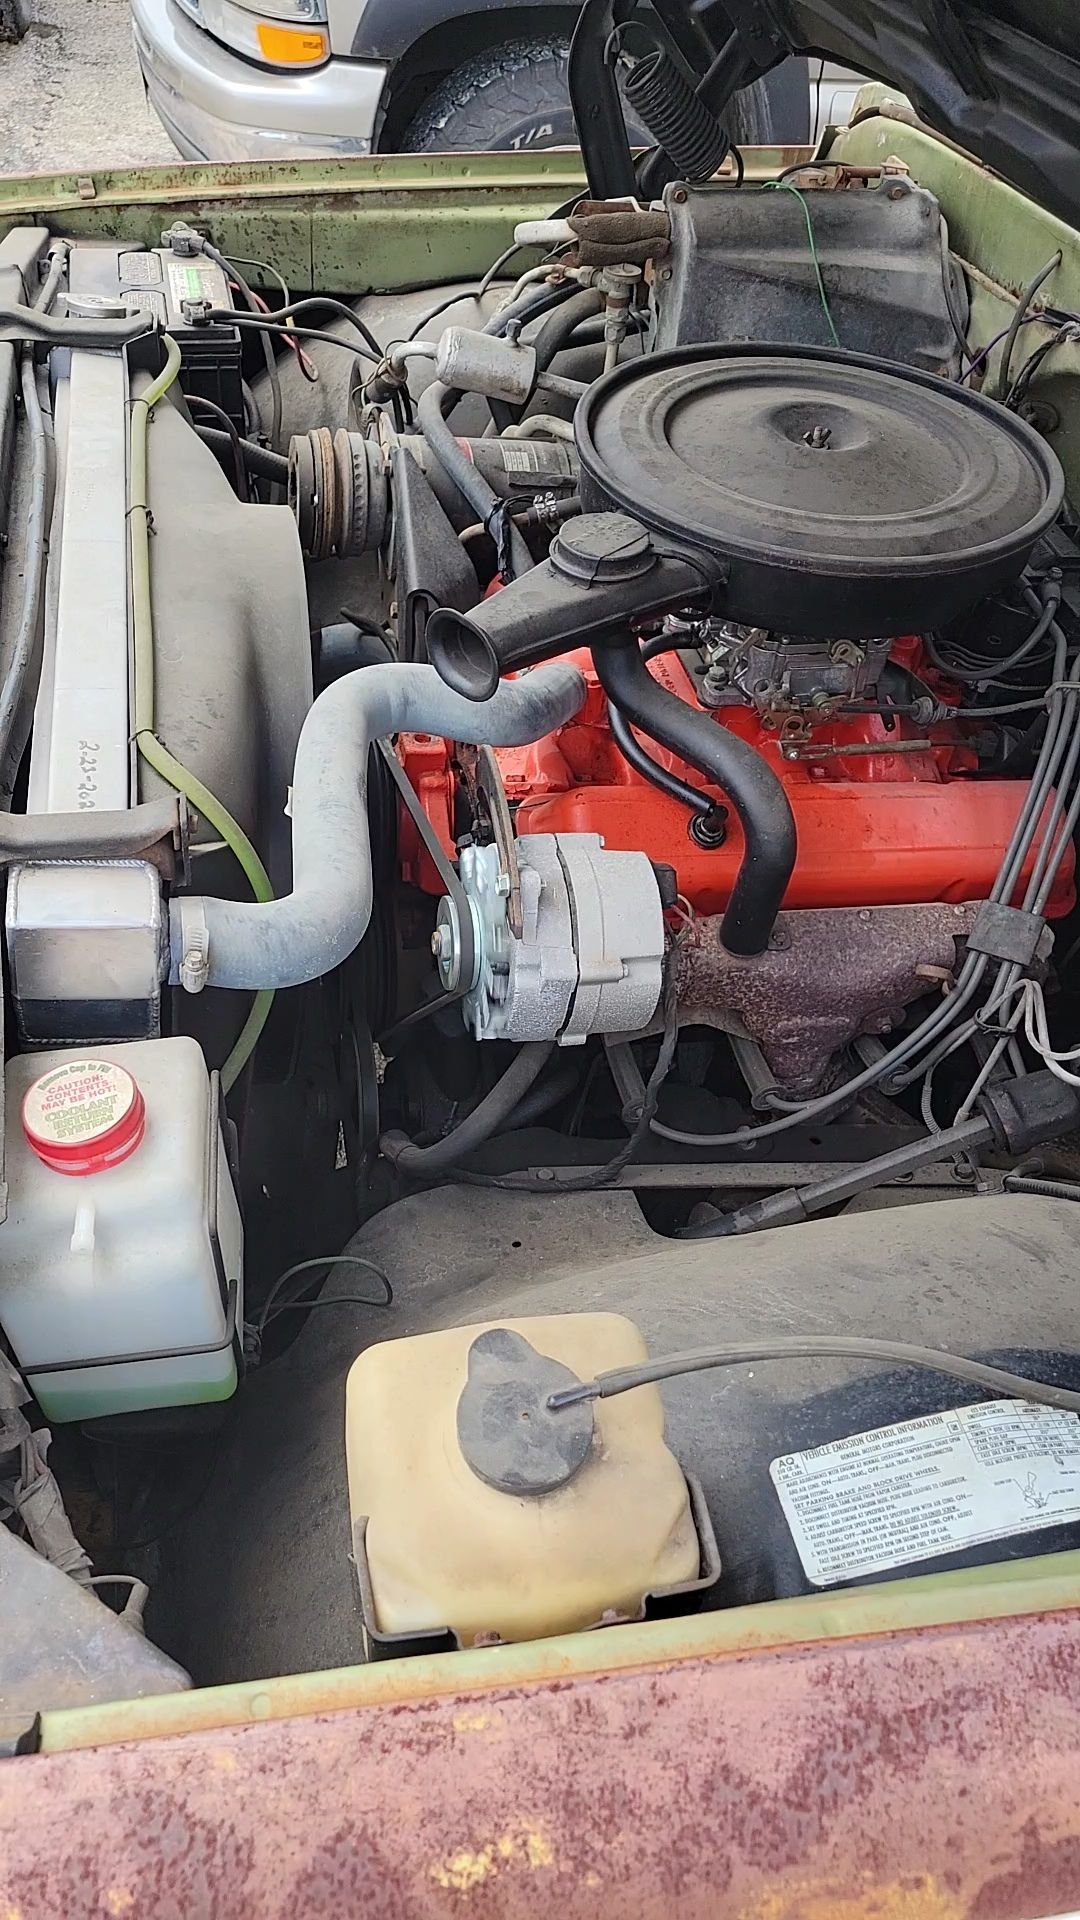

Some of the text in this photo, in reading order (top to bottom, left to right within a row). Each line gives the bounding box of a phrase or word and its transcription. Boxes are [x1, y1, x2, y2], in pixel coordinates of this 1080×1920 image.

[510, 124, 553, 149] T/A
[69, 1065, 86, 1073] Cap
[48, 1074, 103, 1094] CAUTION:
[41, 1099, 66, 1111] MAY
[70, 1094, 86, 1103] BE
[45, 1095, 117, 1122] COOLANT
[53, 1105, 114, 1130] RETURN
[57, 1114, 114, 1138] SYSTEM
[802, 1415, 943, 1460] VEHICLE EMISSION CONTROL INFORMATION
[840, 1435, 914, 1460] GENERAL MOTORS CORPORATION
[777, 1457, 794, 1467] AQ
[806, 1494, 833, 1505] PARKING
[836, 1489, 855, 1497] BRAKE
[873, 1478, 893, 1487] BLOCK
[895, 1473, 912, 1481] DRIVE
